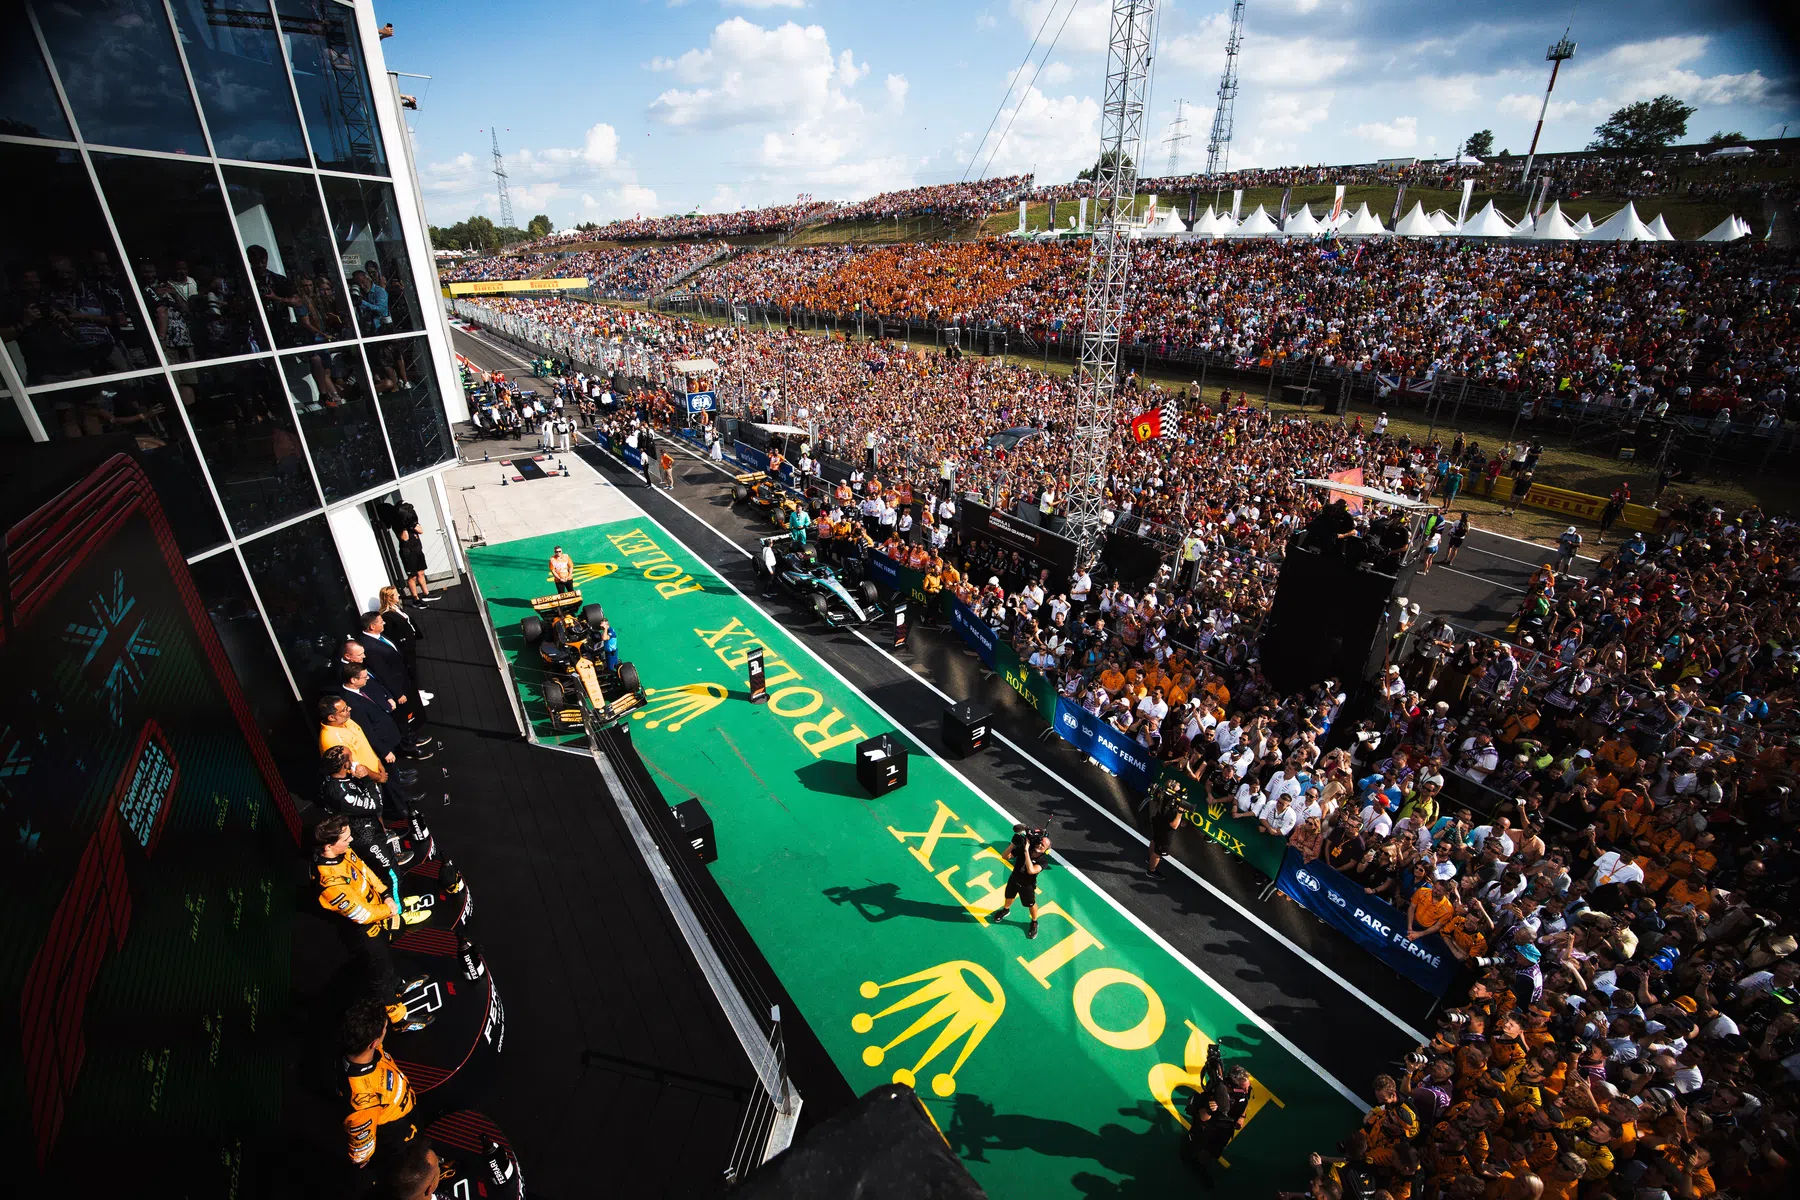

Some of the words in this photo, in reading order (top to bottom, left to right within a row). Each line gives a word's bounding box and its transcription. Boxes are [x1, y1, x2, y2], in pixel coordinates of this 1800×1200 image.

[606, 528, 705, 600] ROLEX
[751, 660, 762, 675] 1
[693, 616, 871, 759] ROLEX
[1005, 671, 1039, 710] ROLEX
[971, 726, 986, 741] 3
[886, 765, 899, 777] 1
[1097, 735, 1118, 755] PARC
[1119, 750, 1147, 772] FERMÉ
[1353, 908, 1391, 937] PARC
[1392, 932, 1441, 969] FERMÉ
[463, 954, 479, 980] FERRARI
[887, 798, 1286, 1169] ROLEX
[489, 1159, 506, 1184] FERRARI
